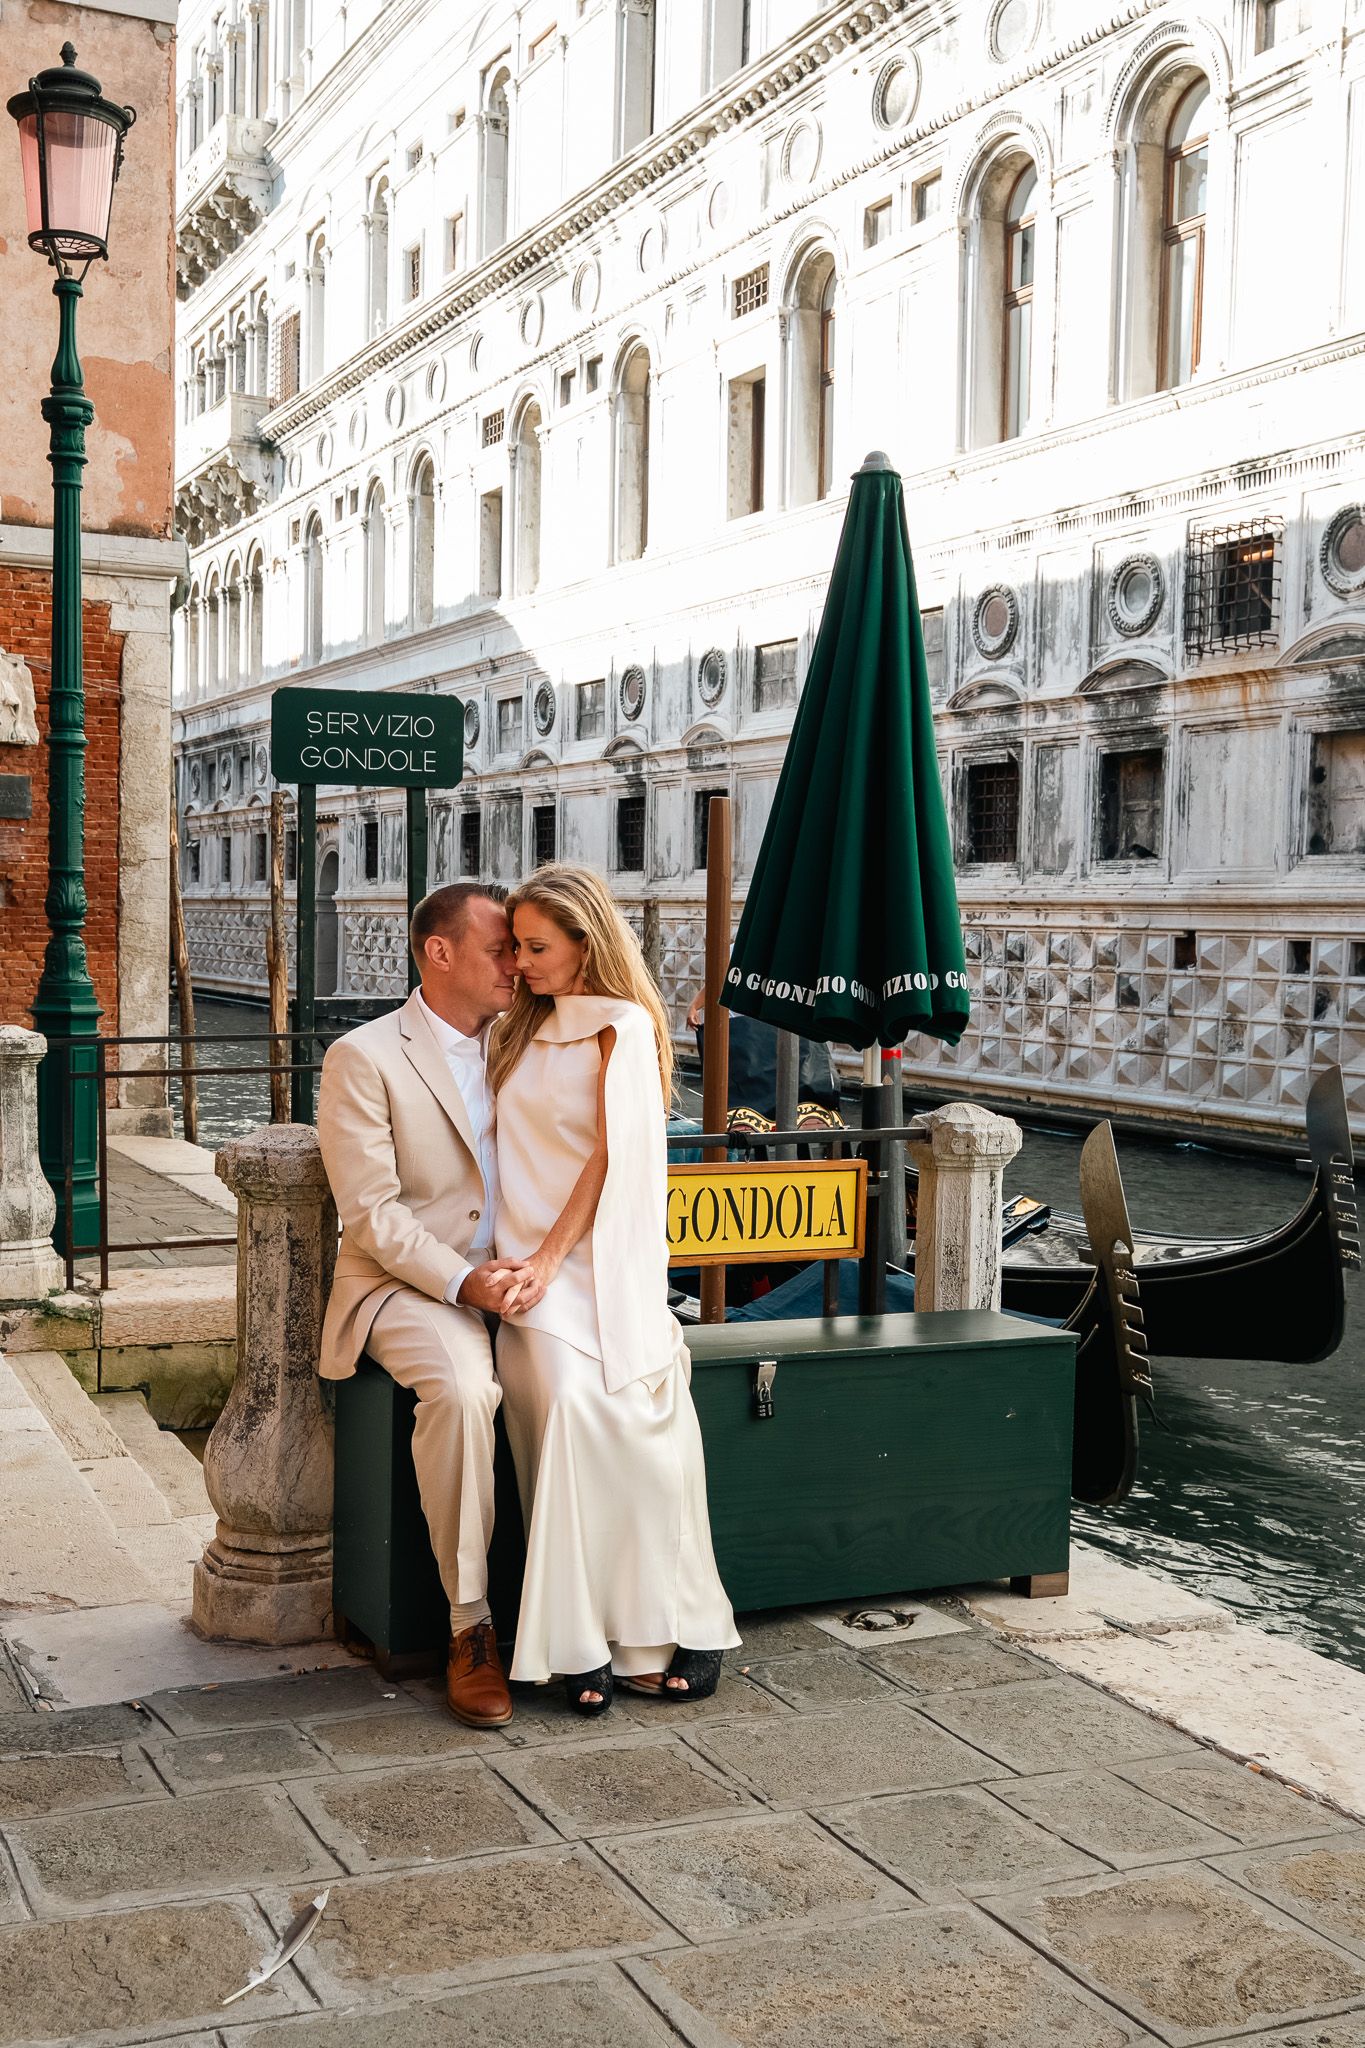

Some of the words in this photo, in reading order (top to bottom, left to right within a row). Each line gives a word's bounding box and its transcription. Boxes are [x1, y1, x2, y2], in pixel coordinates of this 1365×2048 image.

[307, 711, 435, 738] SERVIZIO
[300, 746, 437, 773] GONDOLE
[666, 1184, 848, 1244] GONDOLA
